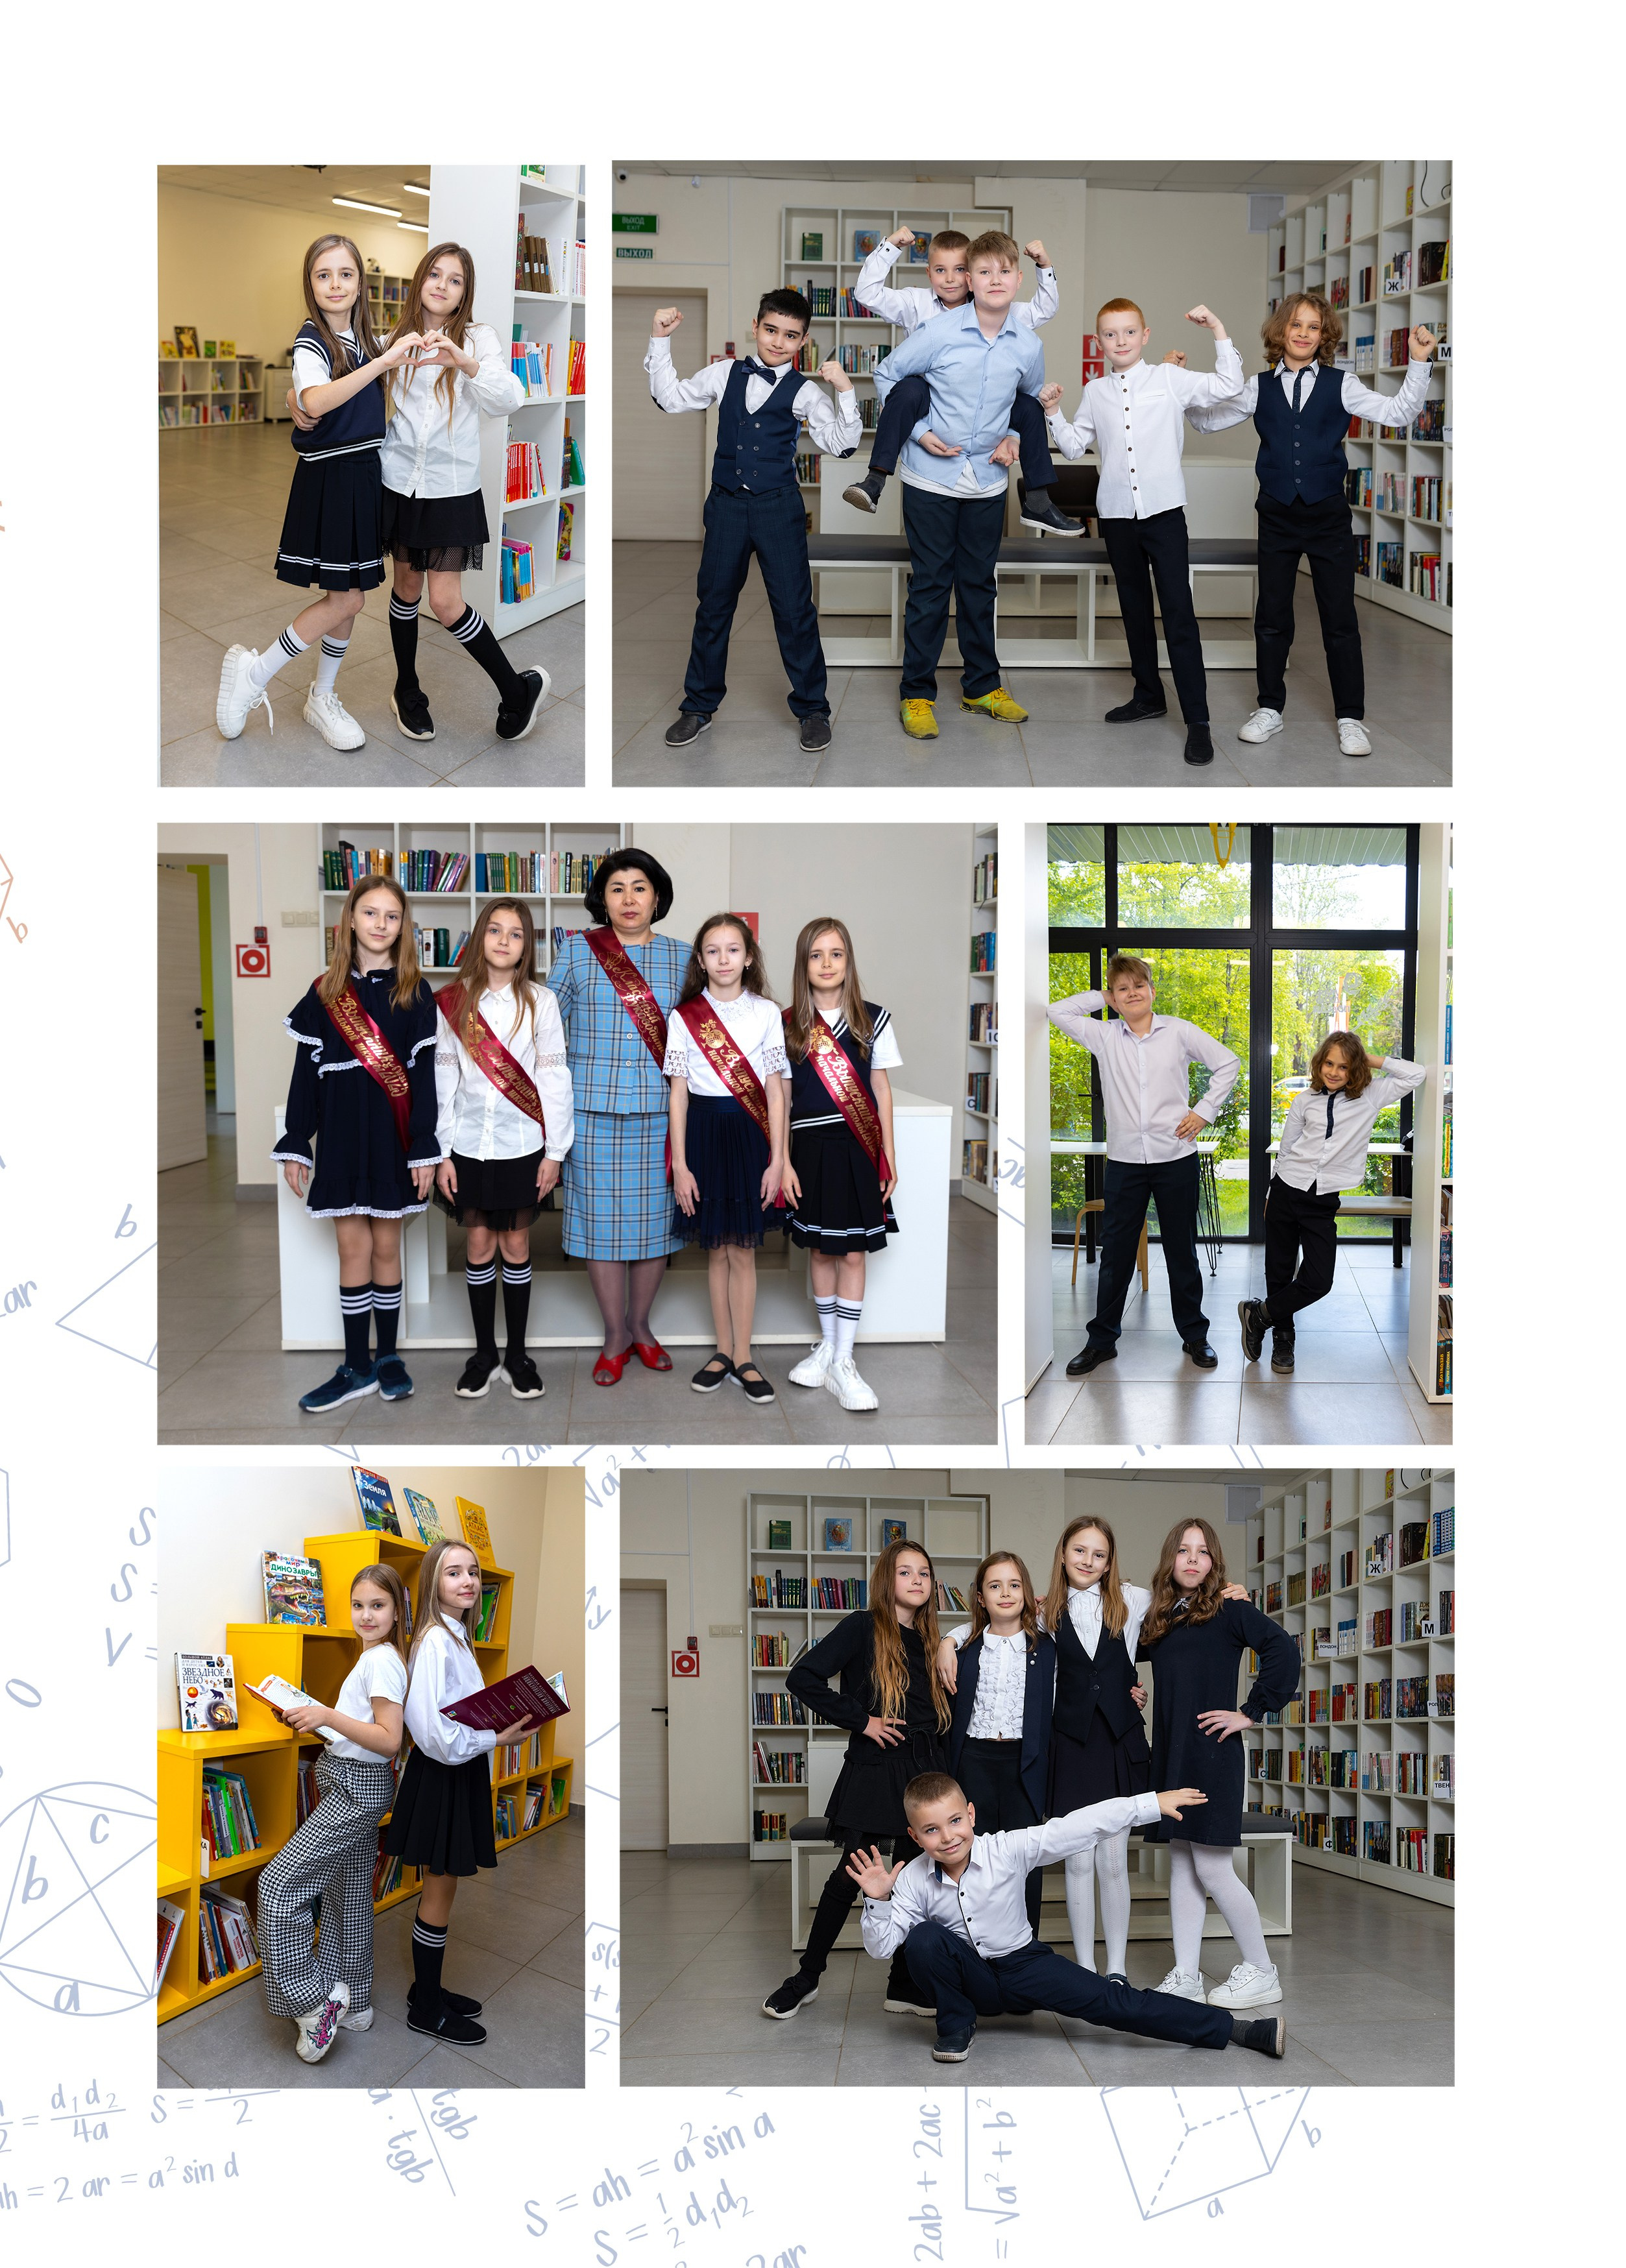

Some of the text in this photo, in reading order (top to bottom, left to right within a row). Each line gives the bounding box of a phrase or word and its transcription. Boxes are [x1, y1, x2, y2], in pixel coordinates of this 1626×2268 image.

[622, 216, 645, 226] ВЫХОД
[618, 248, 652, 259] ВЫХОД
[1388, 282, 1400, 291] Ж
[613, 967, 661, 1023] Классный
[326, 1000, 384, 1074] ачальной школы
[338, 996, 394, 1065] Выпускник
[481, 1043, 539, 1103] Выпускник
[707, 1048, 745, 1094] начальной
[815, 1054, 868, 1136] начальной школы
[827, 1055, 875, 1126] Выпускник
[507, 1089, 535, 1113] школы
[363, 1480, 387, 1497] Земля
[276, 1555, 309, 1564] красочный
[1370, 1563, 1381, 1573] Ж
[271, 1563, 317, 1577] ДИНОЗАВРЫ
[182, 1667, 225, 1677] ЗВЕЗДНОЕ
[1326, 1840, 1333, 1849] Ф
